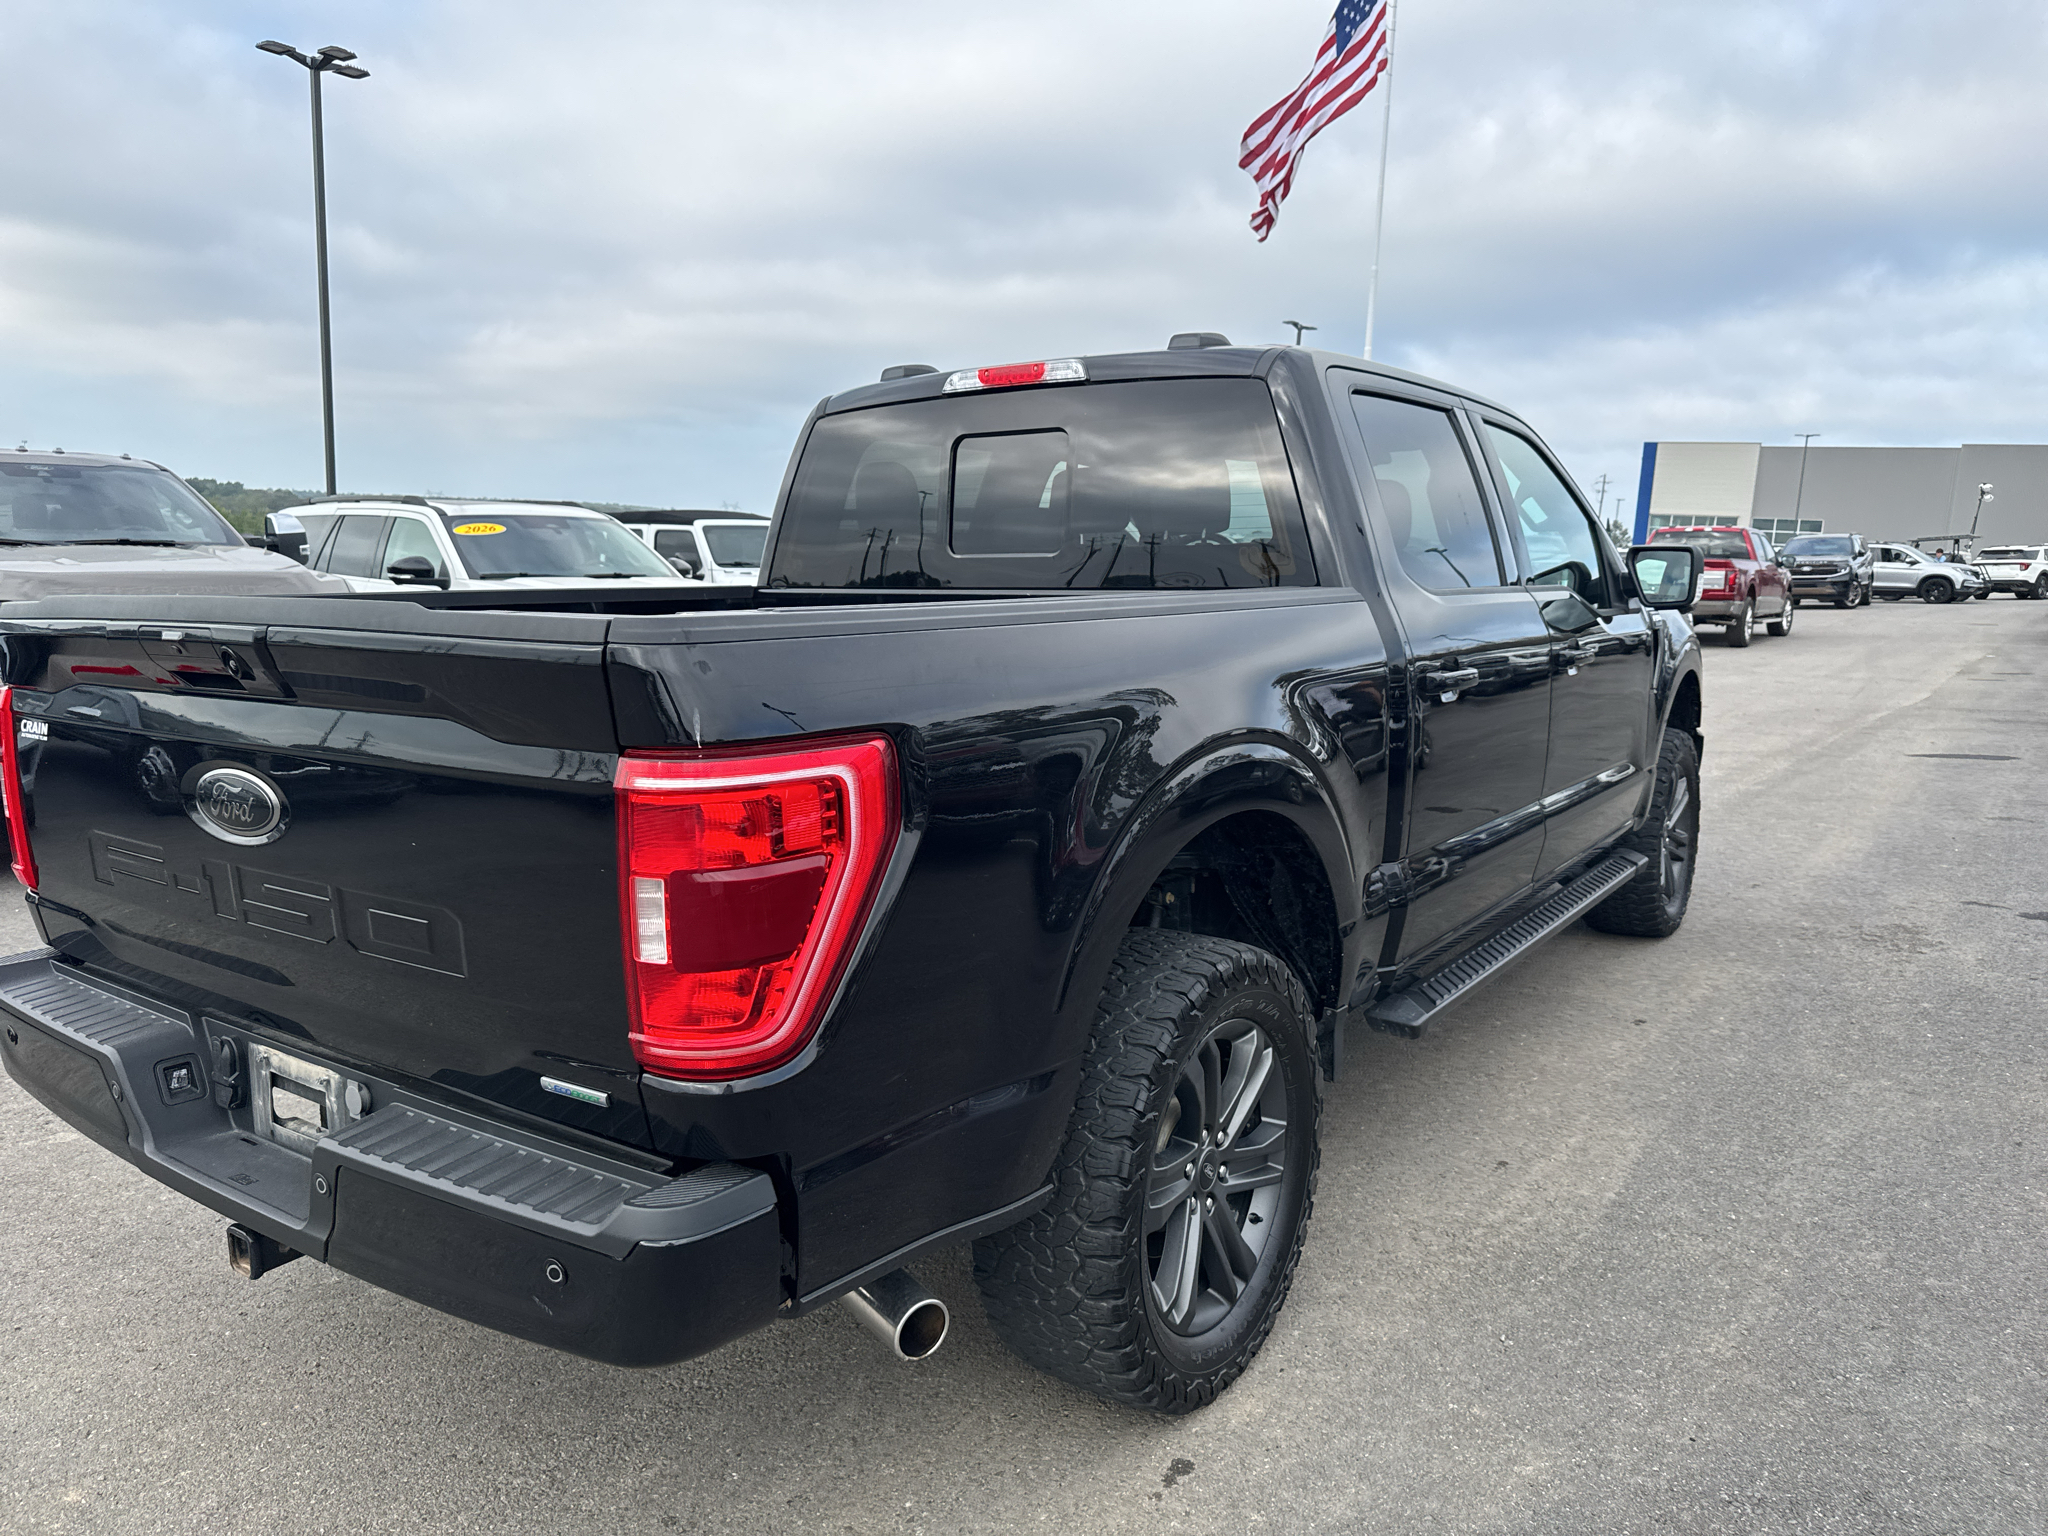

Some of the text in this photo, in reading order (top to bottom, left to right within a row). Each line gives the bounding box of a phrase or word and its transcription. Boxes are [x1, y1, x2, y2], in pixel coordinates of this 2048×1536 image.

[464, 525, 497, 534] 2026
[21, 719, 48, 735] CRAIN
[210, 782, 255, 823] Ford
[88, 829, 468, 979] F-150
